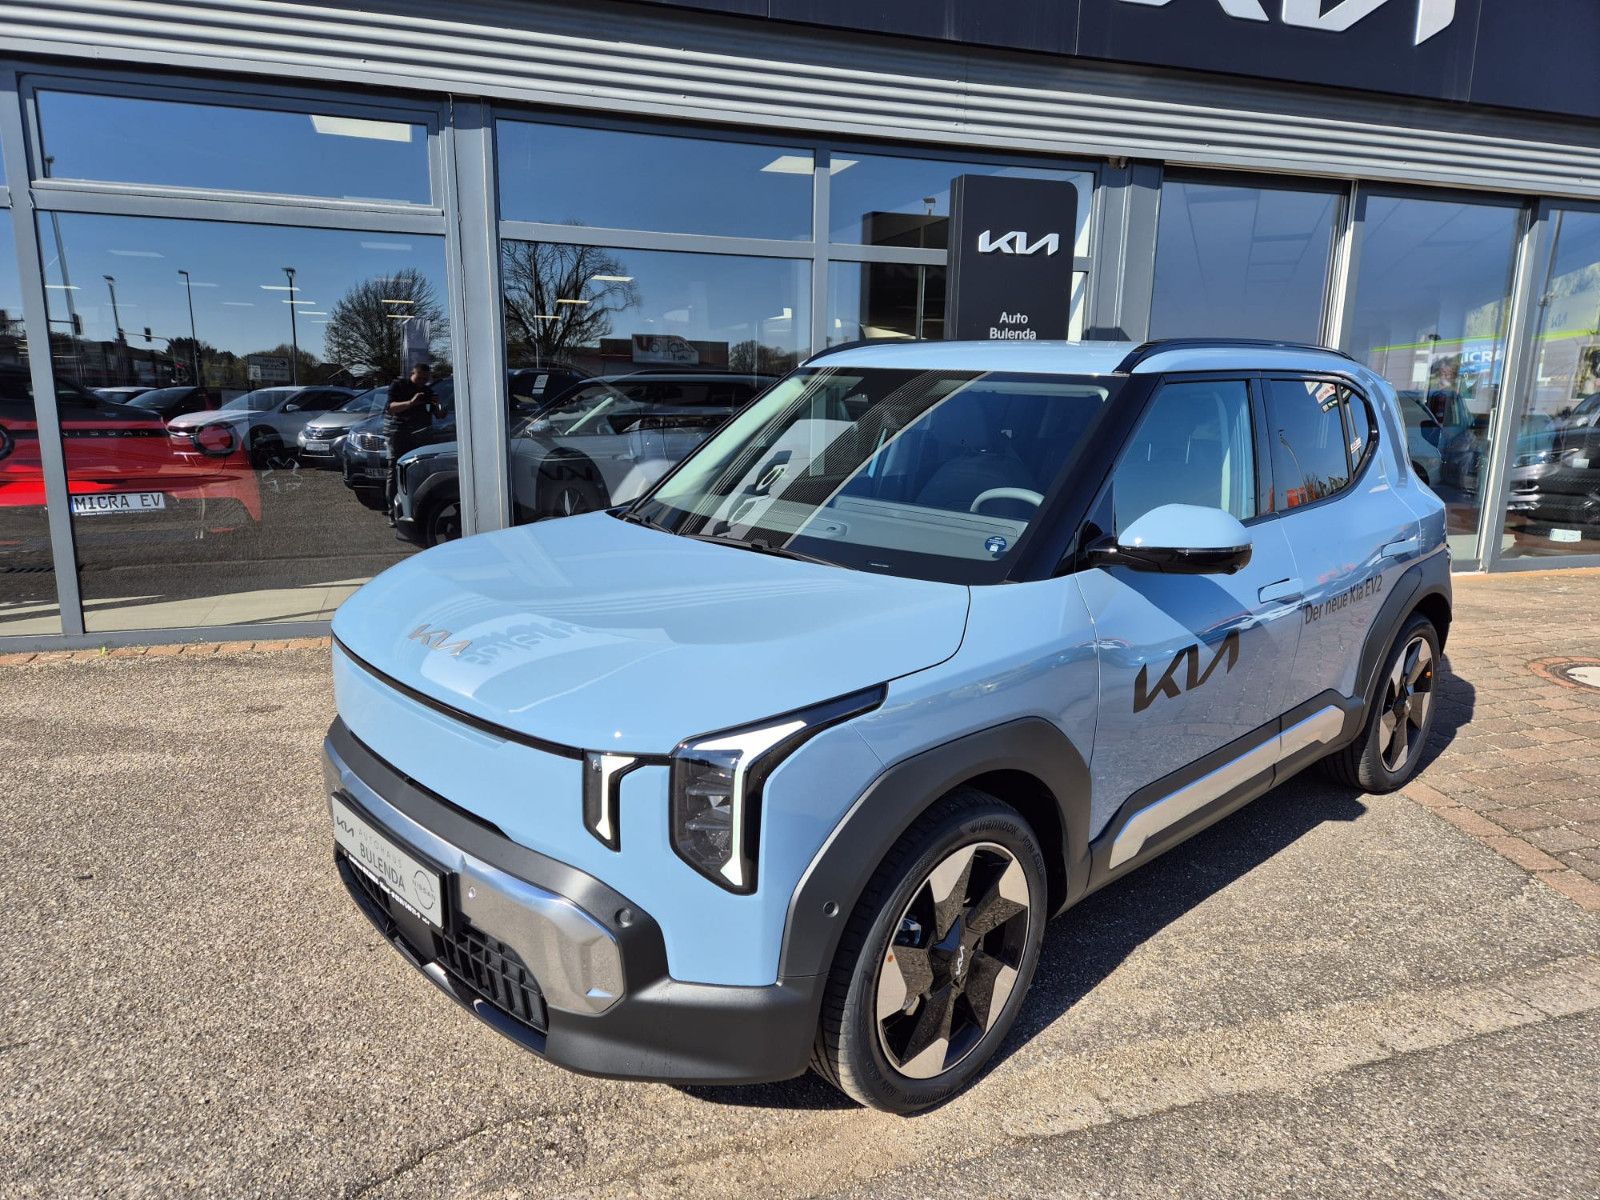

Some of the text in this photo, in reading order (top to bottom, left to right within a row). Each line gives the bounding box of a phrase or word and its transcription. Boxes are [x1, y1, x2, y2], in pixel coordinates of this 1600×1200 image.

[978, 230, 1060, 256] KIA
[1000, 312, 1029, 324] Auto
[990, 327, 1037, 341] Bulenda
[74, 494, 161, 511] MICRA EV
[1305, 574, 1383, 625] Der neue Kia EV2
[408, 623, 473, 657] KIA
[1132, 626, 1240, 714] KIA
[336, 816, 355, 838] KIA
[360, 842, 406, 892] BULENDA
